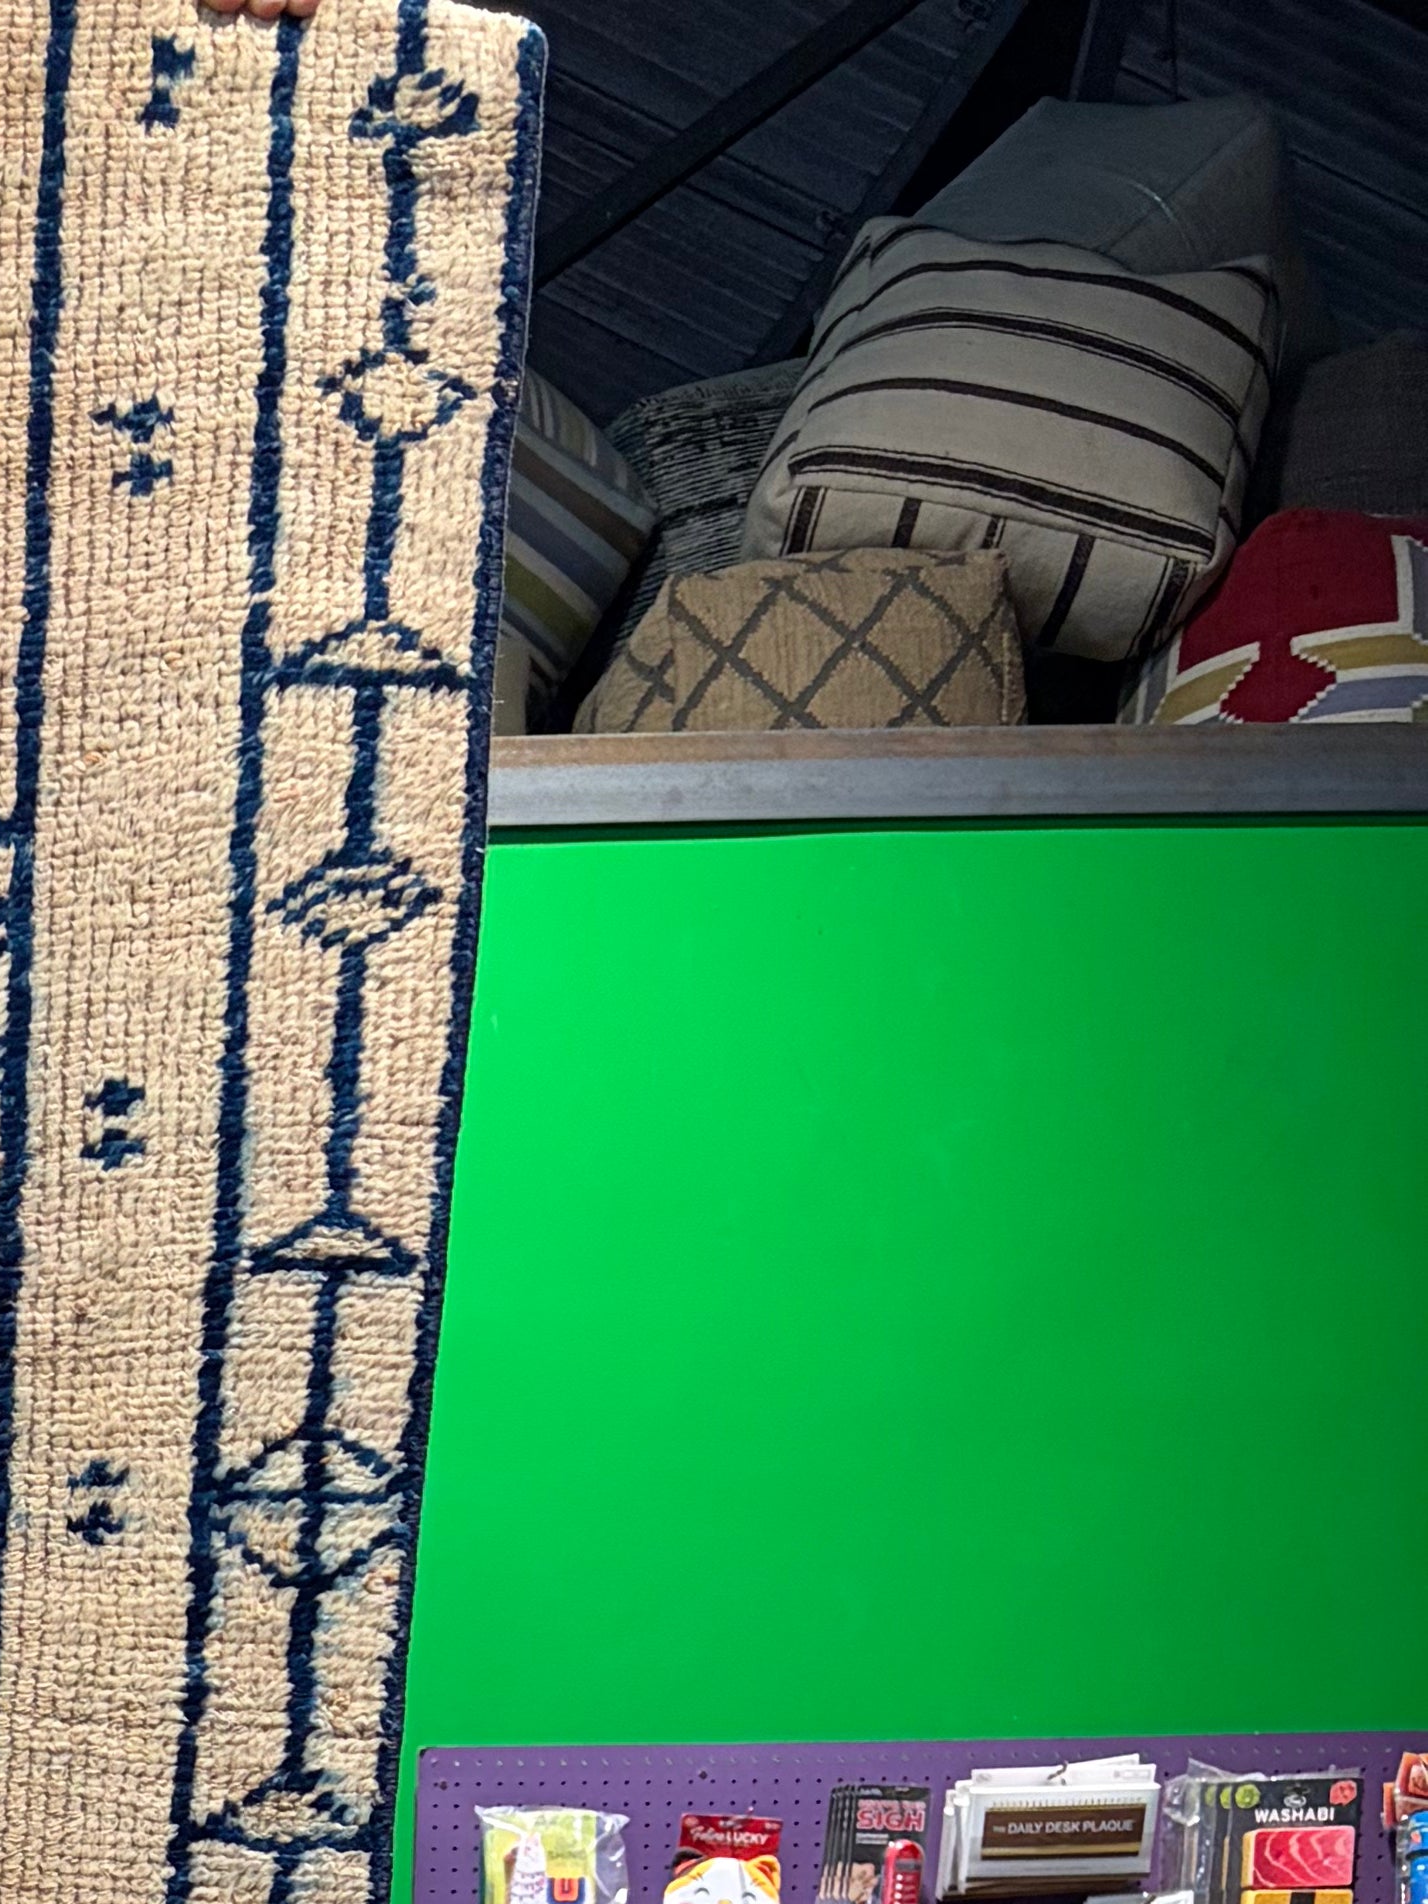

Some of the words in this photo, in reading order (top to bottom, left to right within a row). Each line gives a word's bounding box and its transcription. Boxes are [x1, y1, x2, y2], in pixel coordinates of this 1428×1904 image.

[856, 1809, 926, 1832] SIGH
[1254, 1806, 1335, 1824] WASHABI
[1007, 1820, 1043, 1835] DAILY
[1045, 1820, 1080, 1833] DESK
[1082, 1818, 1135, 1832] PLAQUE
